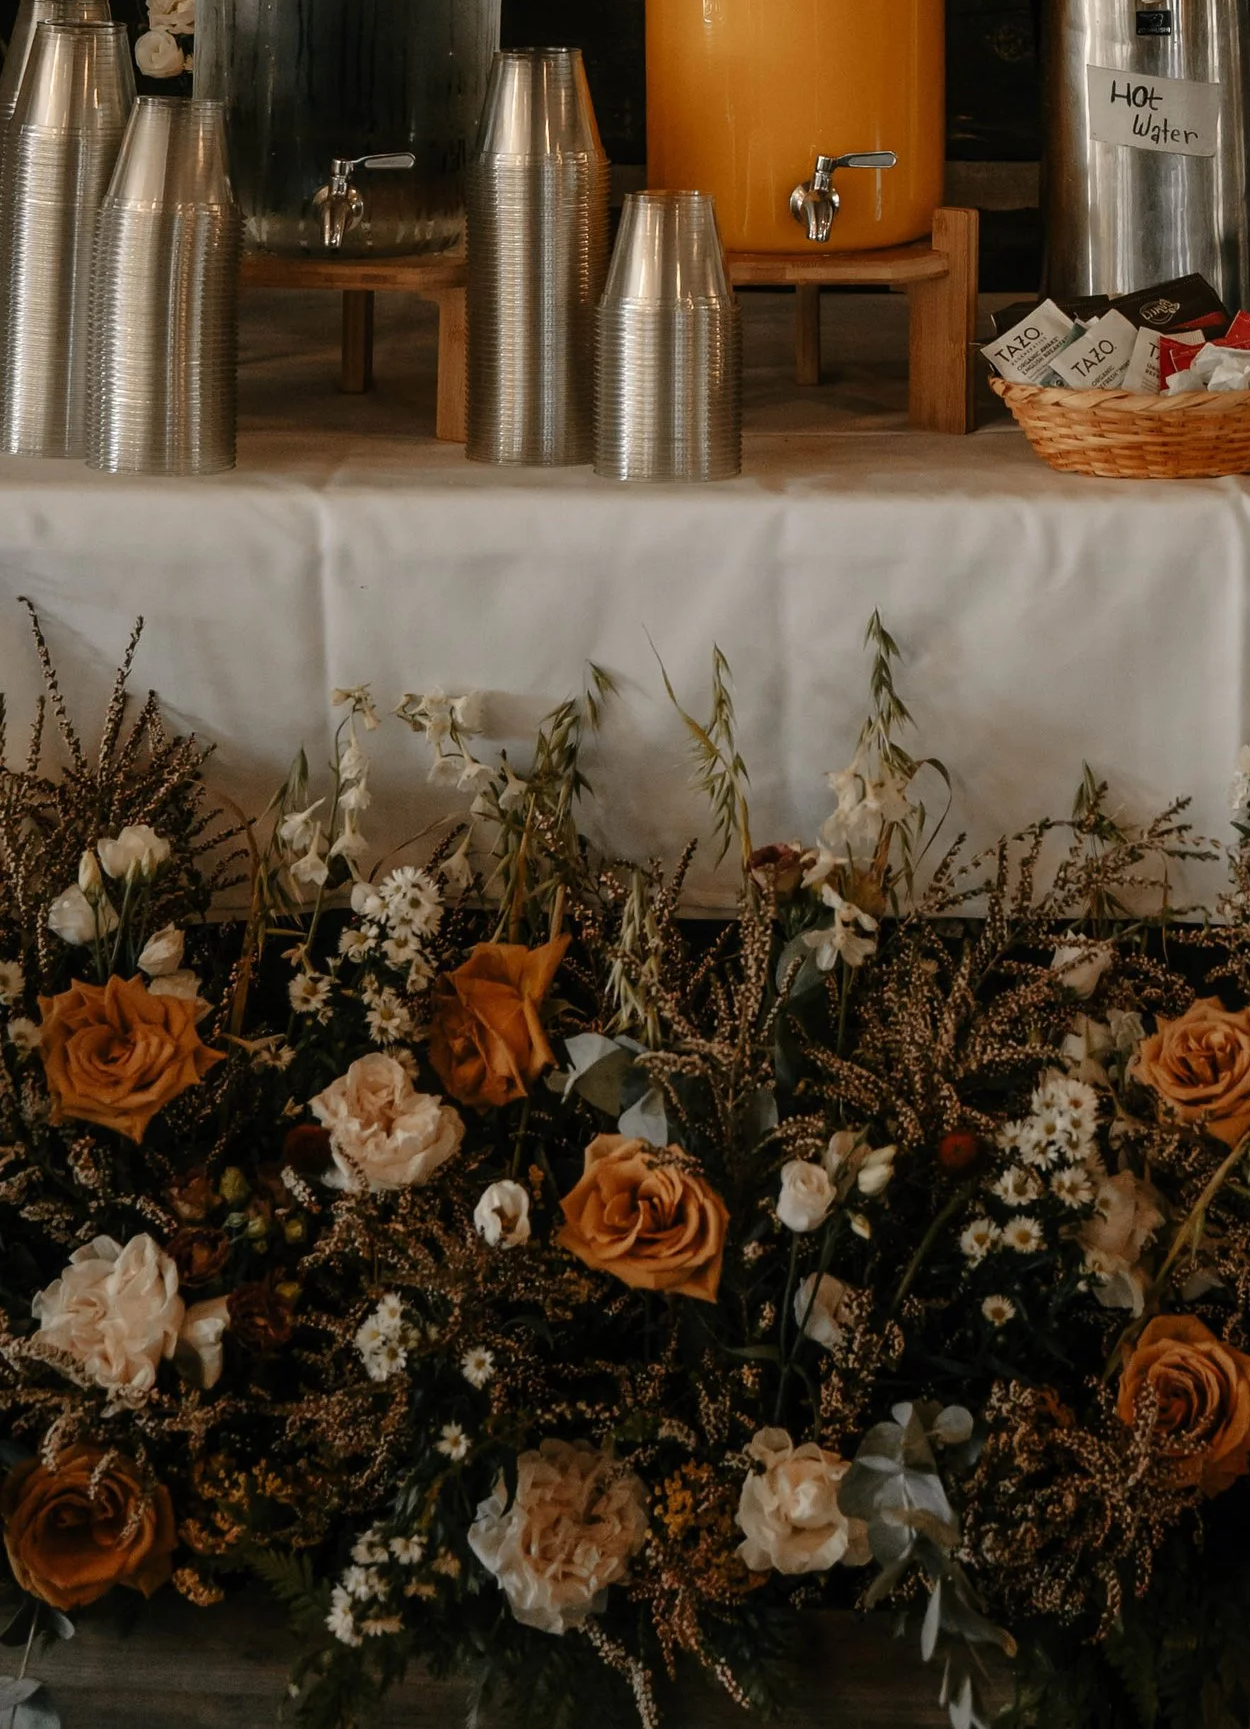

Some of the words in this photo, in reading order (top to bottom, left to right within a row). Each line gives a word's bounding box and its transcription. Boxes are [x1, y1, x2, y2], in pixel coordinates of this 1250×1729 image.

[1132, 113, 1198, 145] Water
[994, 327, 1042, 363] TAZO
[1071, 339, 1115, 377] TAZO
